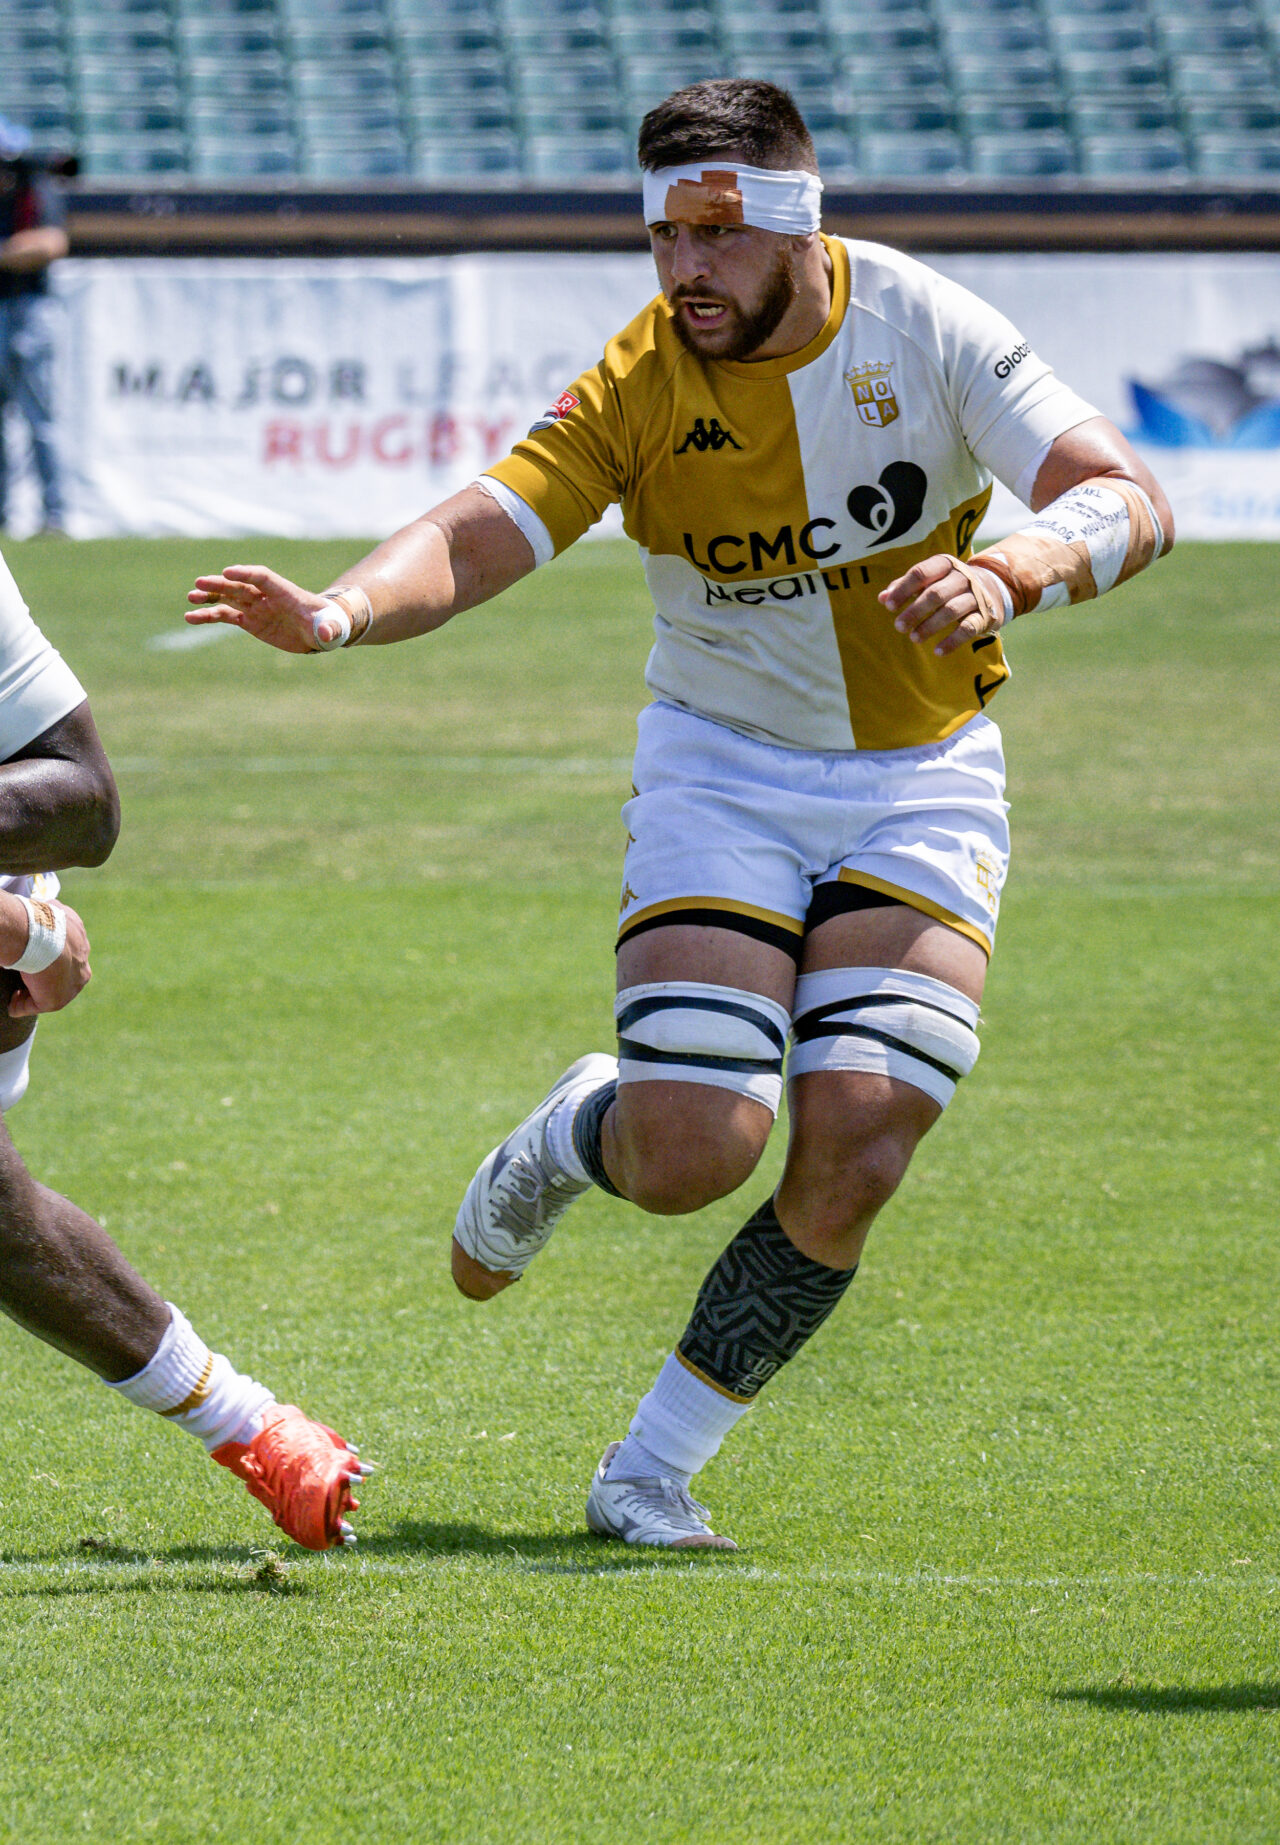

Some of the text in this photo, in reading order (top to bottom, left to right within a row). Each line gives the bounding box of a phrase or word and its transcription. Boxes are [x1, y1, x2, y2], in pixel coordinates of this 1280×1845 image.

[111, 355, 368, 408] MAJOR
[261, 416, 517, 474] RUGBY
[683, 517, 842, 574] LCMC
